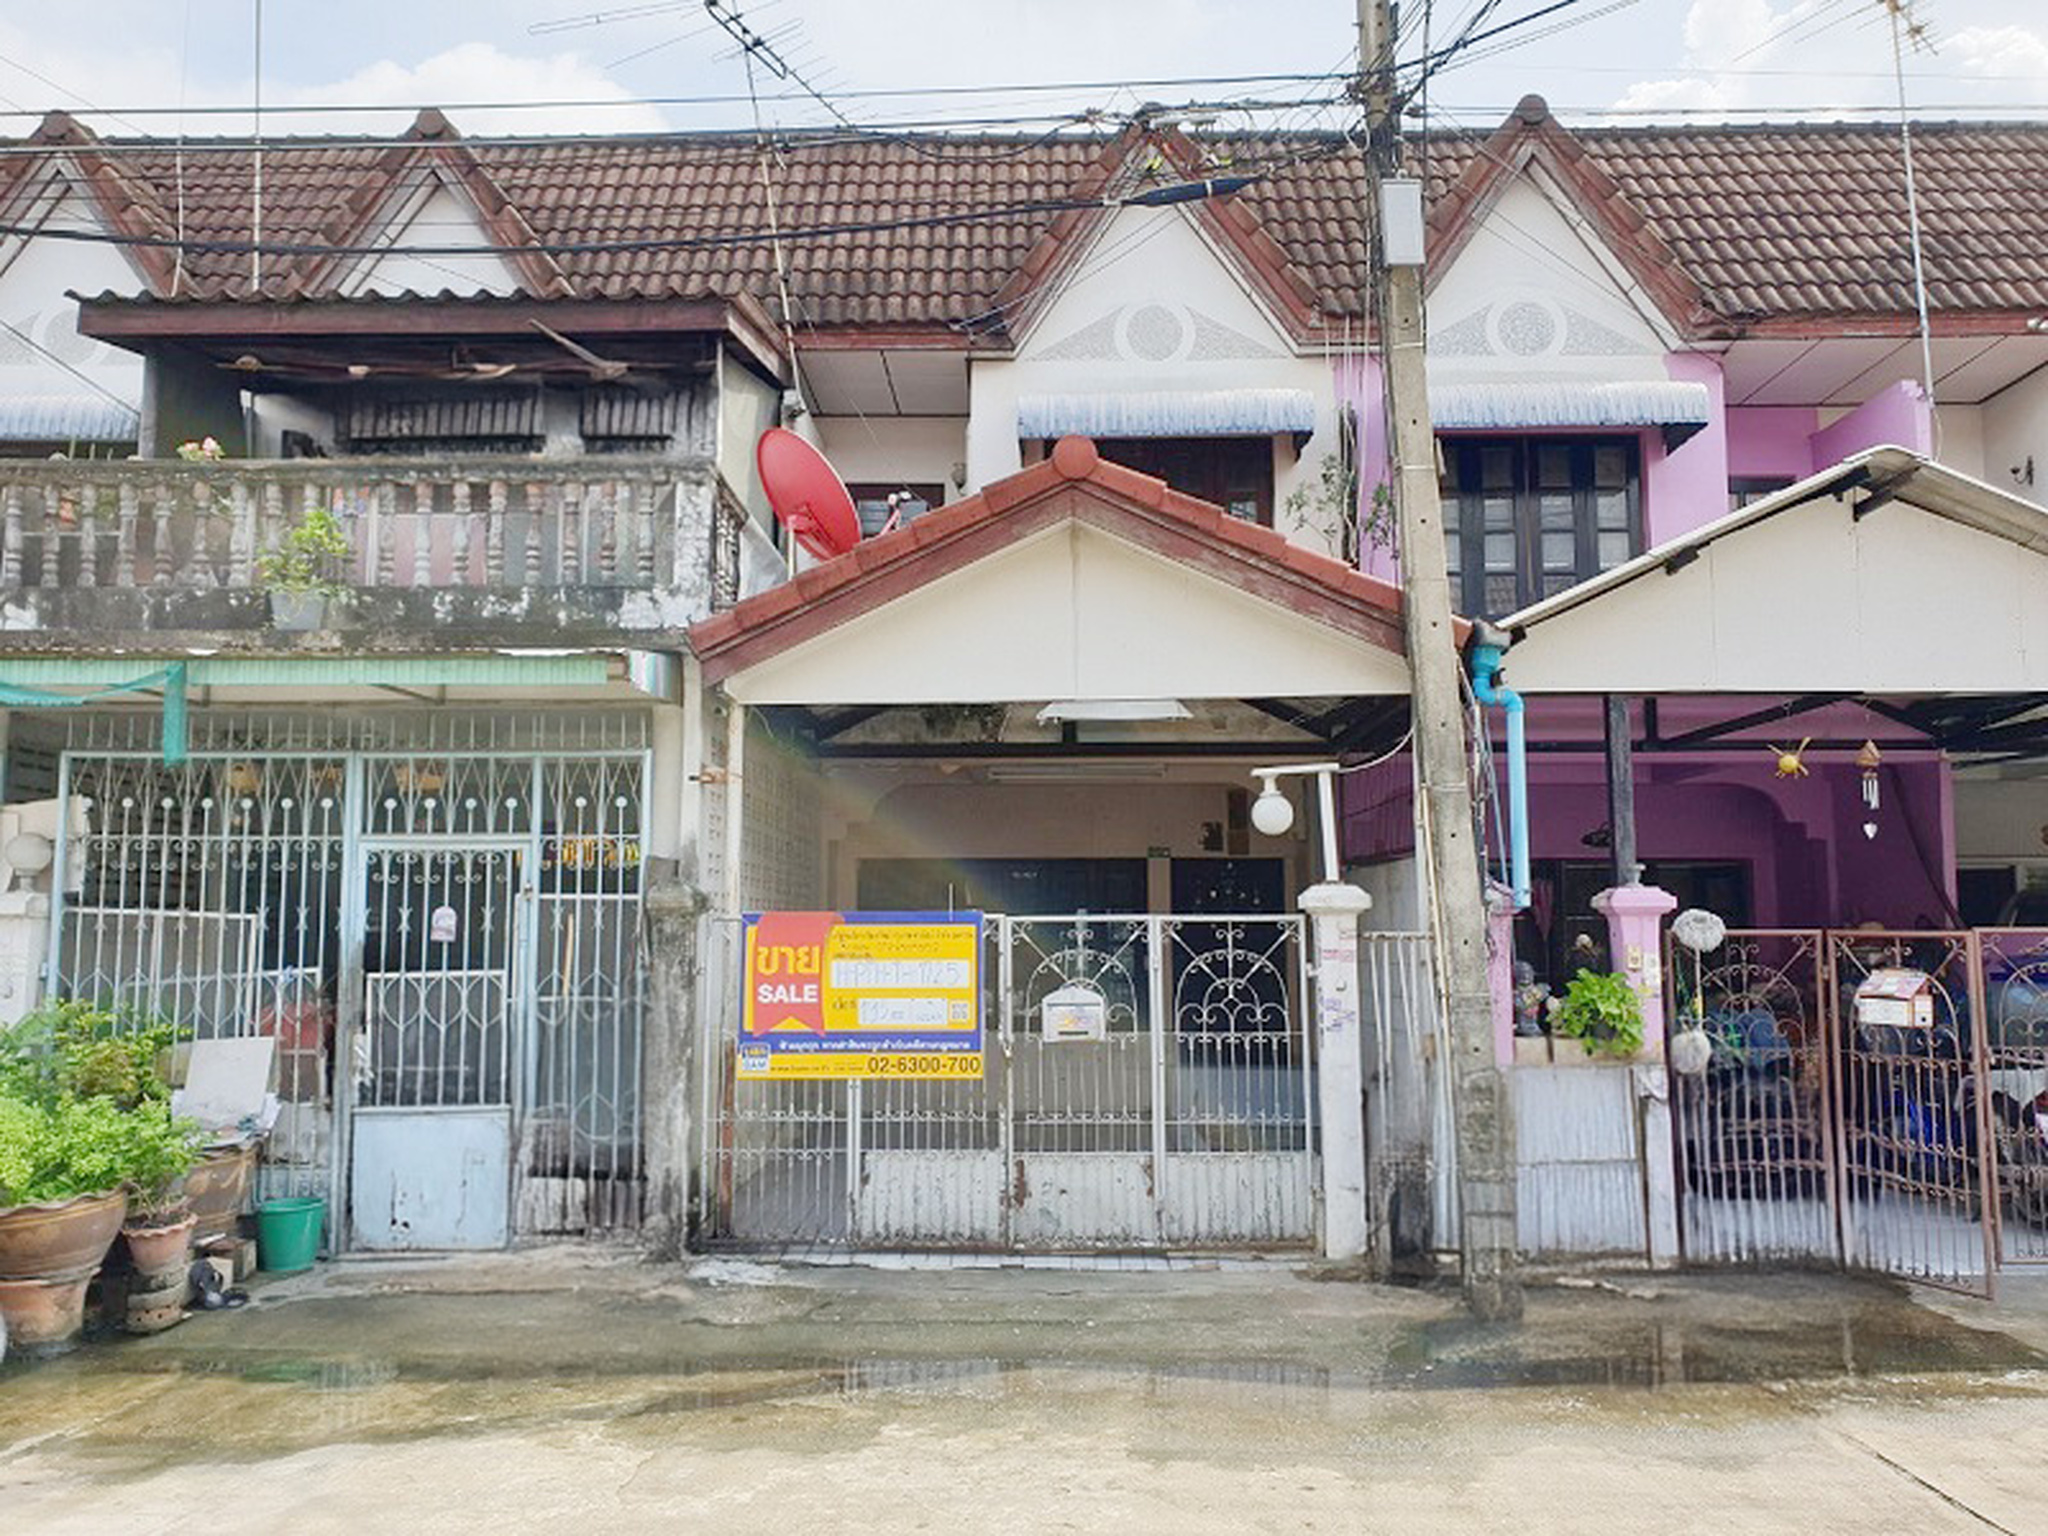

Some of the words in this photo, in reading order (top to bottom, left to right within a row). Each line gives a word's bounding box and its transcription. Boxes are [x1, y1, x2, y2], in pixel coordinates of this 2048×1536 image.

[757, 946, 820, 976] ขาย
[757, 983, 819, 1004] SALE
[867, 1056, 981, 1073] 02-6300-700
